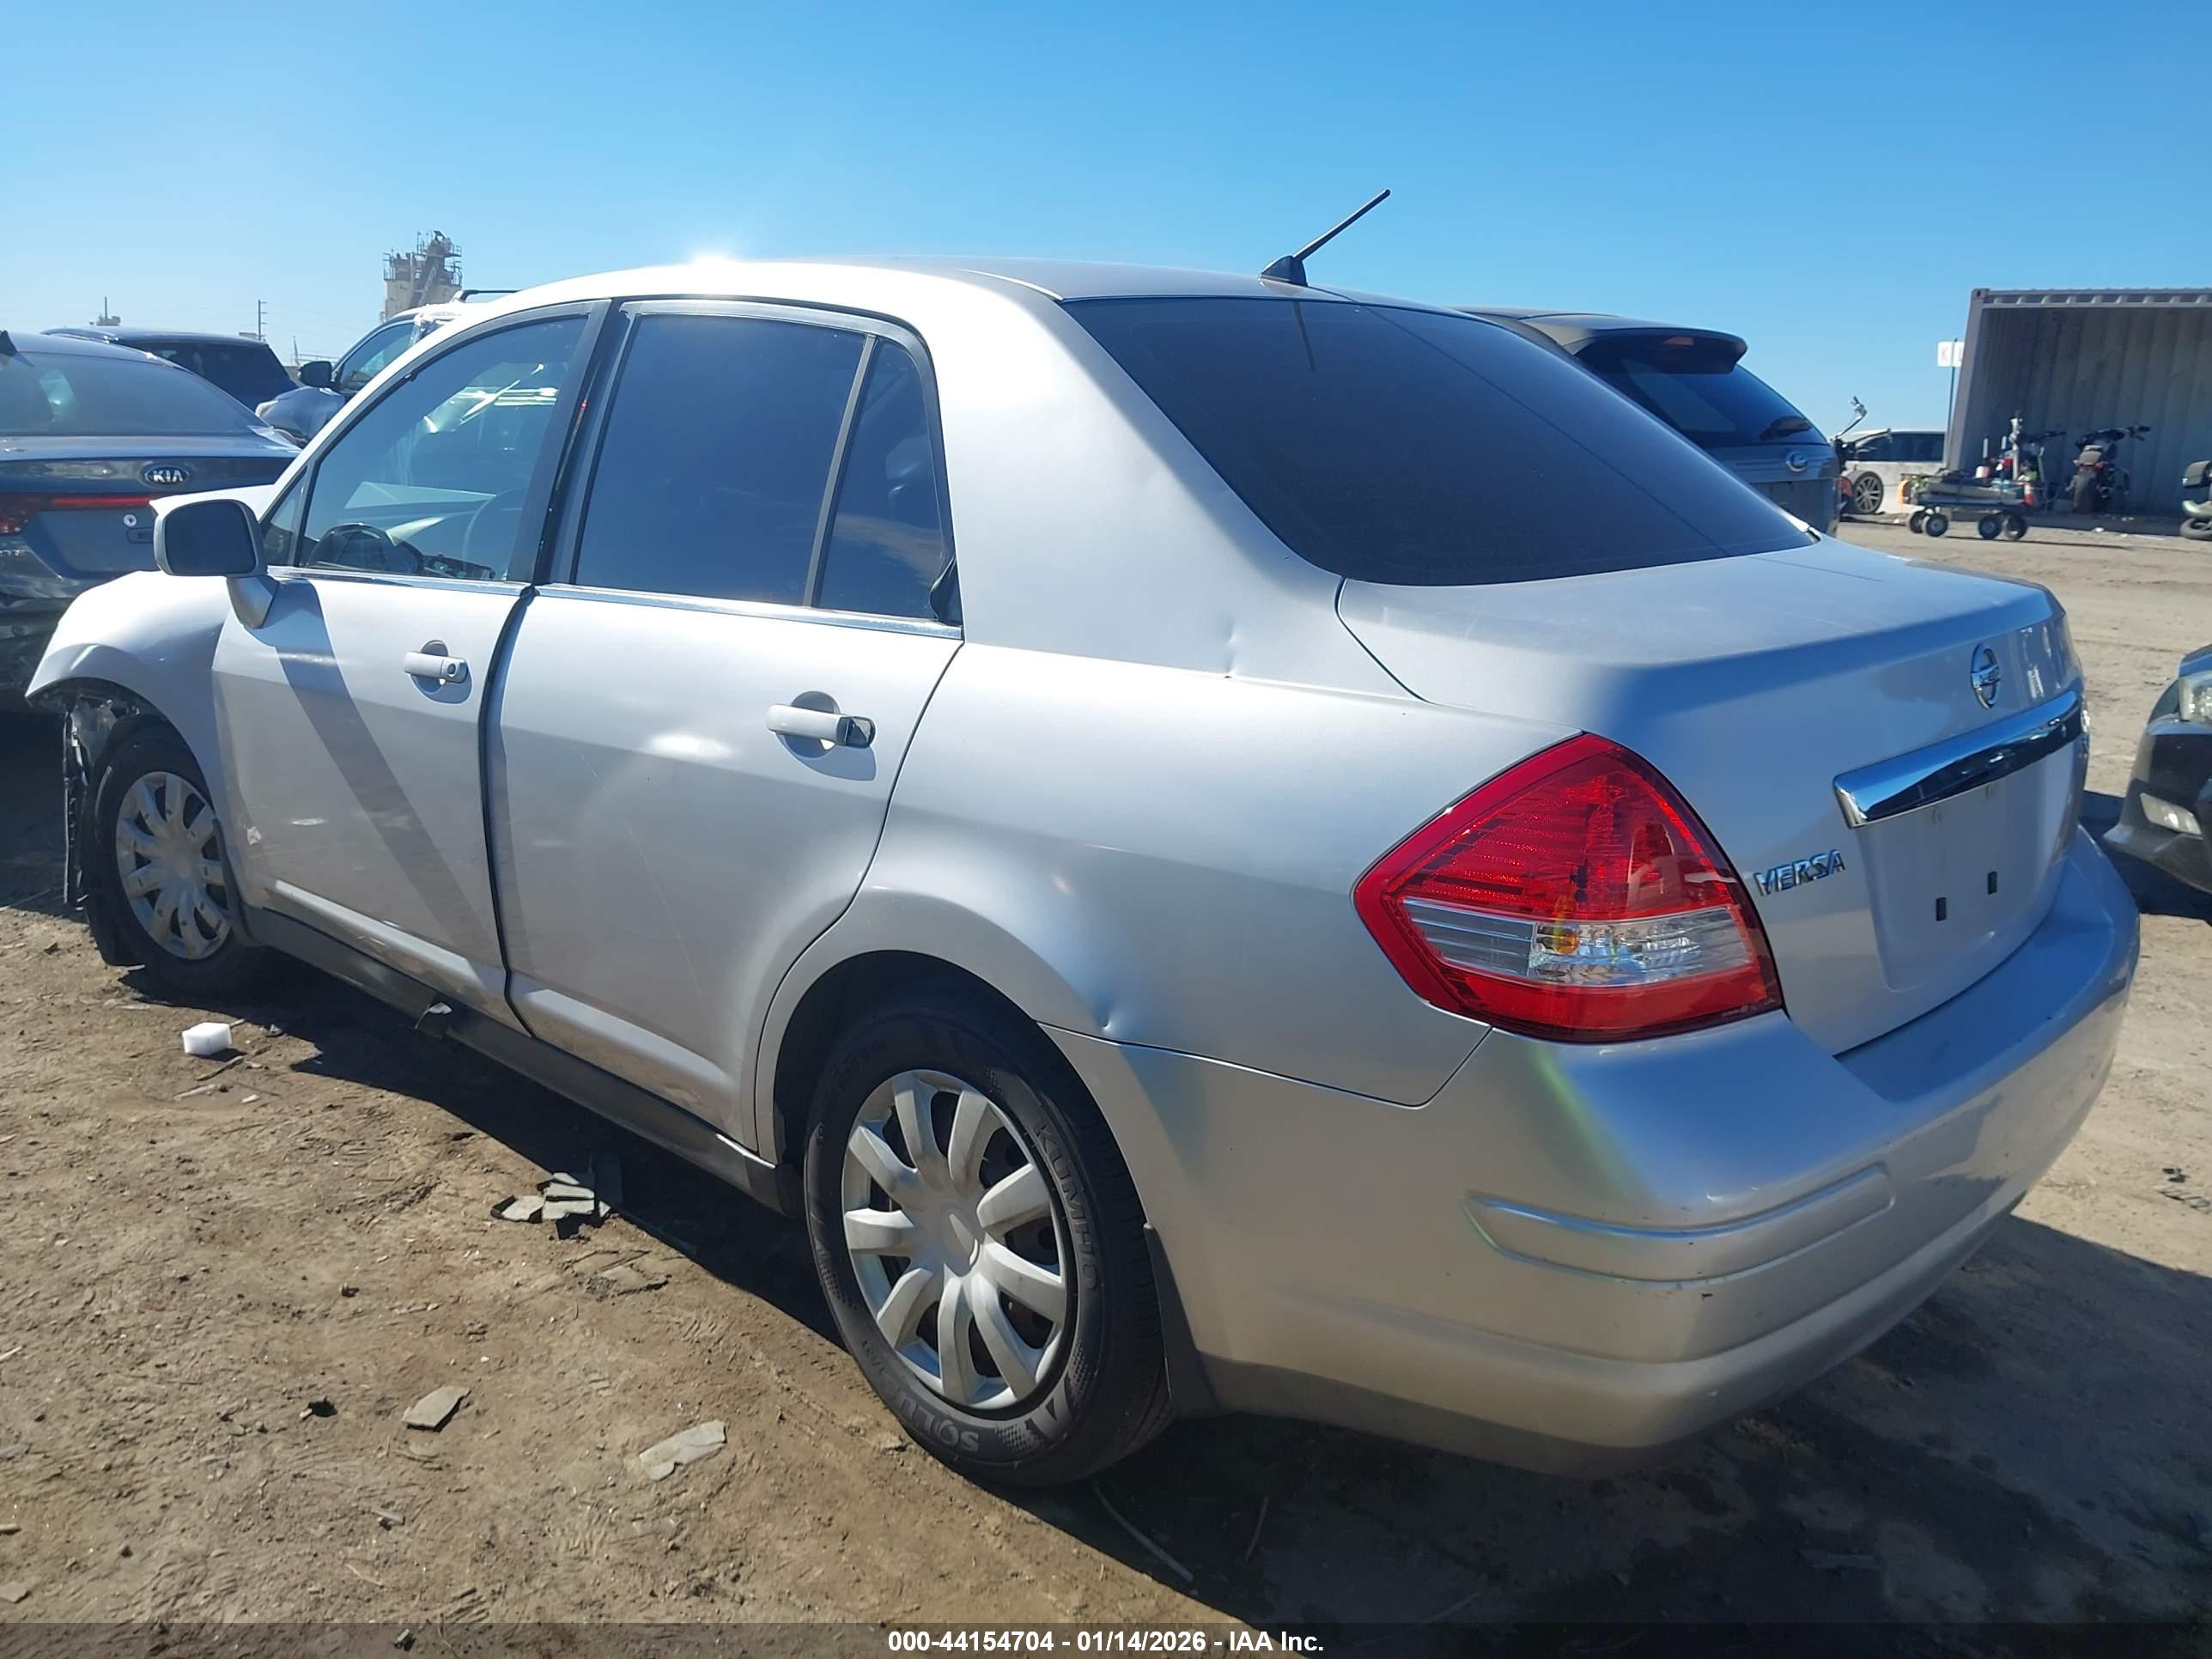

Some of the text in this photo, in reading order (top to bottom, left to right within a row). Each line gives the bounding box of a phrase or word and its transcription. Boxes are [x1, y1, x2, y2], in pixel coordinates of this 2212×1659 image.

[153, 470, 183, 483] KIA
[1753, 849, 1845, 896] VERSA
[1036, 1124, 1097, 1291] KUMHO
